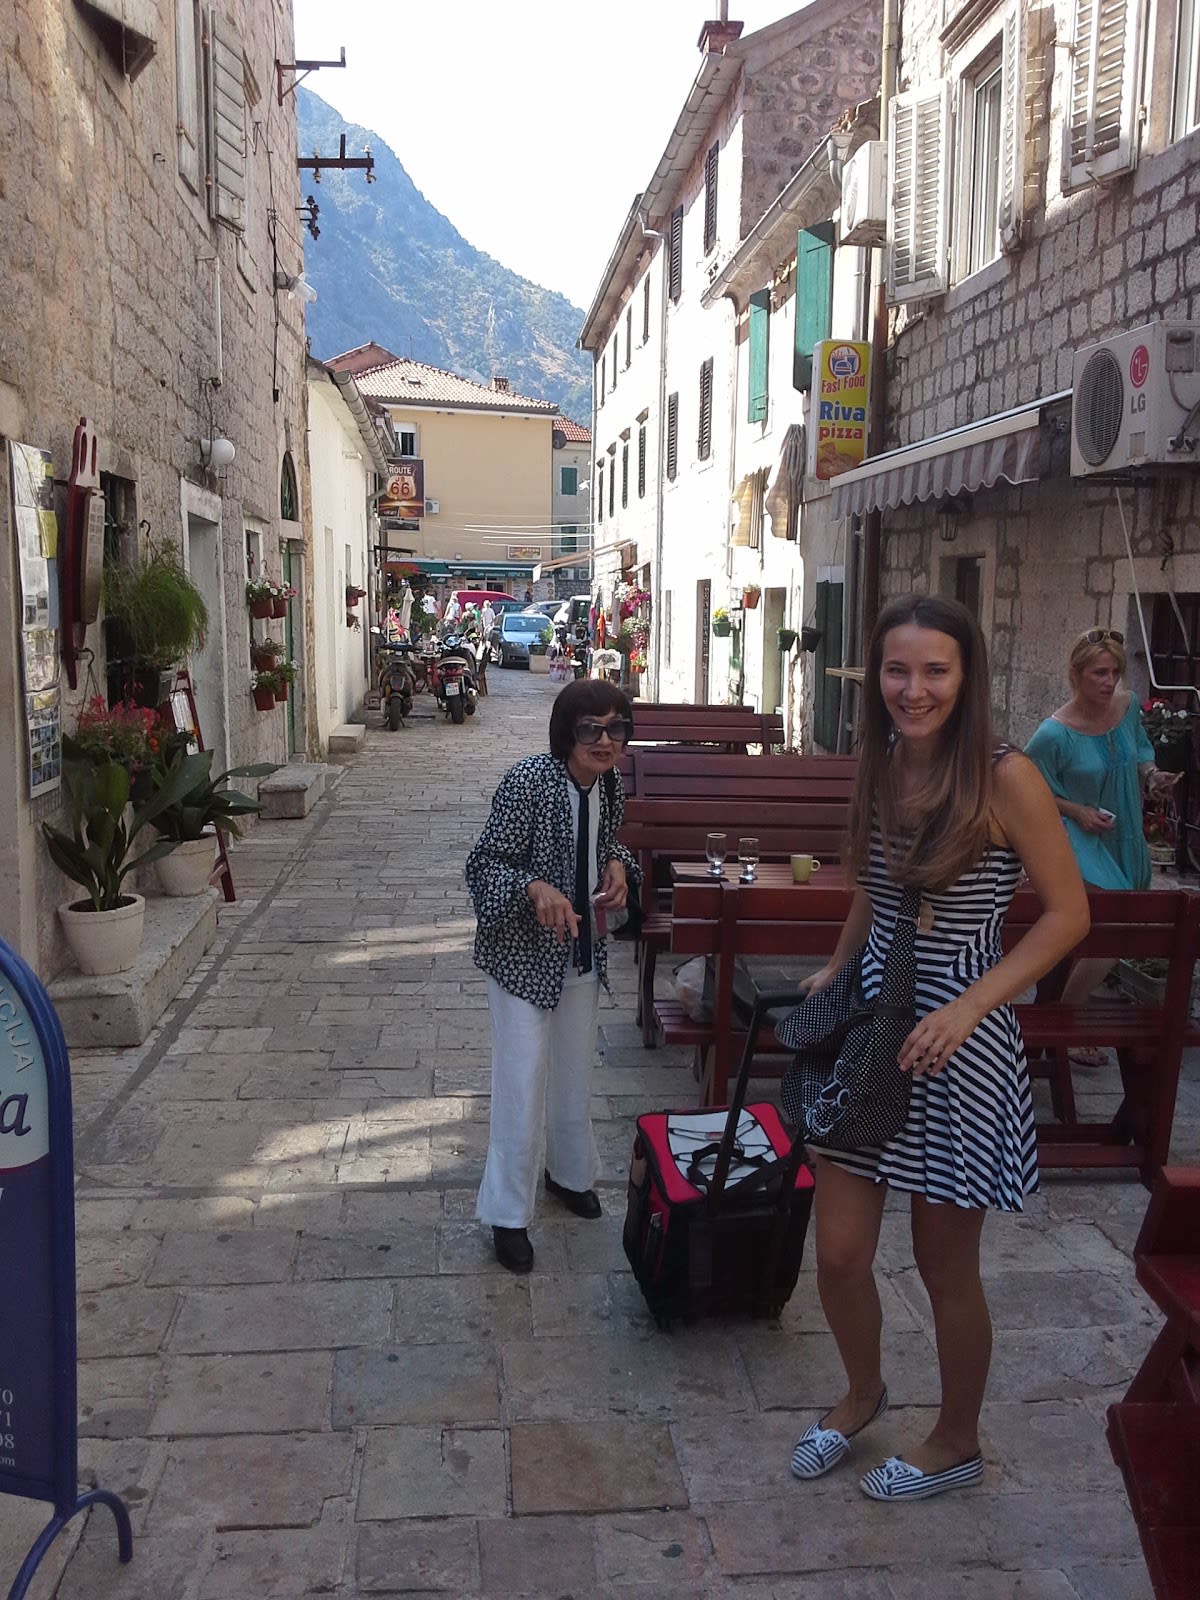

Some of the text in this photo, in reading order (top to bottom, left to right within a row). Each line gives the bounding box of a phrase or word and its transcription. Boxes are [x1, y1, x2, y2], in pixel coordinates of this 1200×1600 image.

[821, 374, 865, 393] Fast Food
[820, 400, 865, 422] Riva
[1131, 393, 1146, 414] LG
[818, 423, 863, 441] pizza
[388, 466, 412, 475] ROUTE
[391, 482, 410, 495] 66
[0, 986, 35, 1073] CIJA
[0, 1092, 32, 1137] a
[0, 1388, 14, 1405] 0
[0, 1410, 11, 1427] 1
